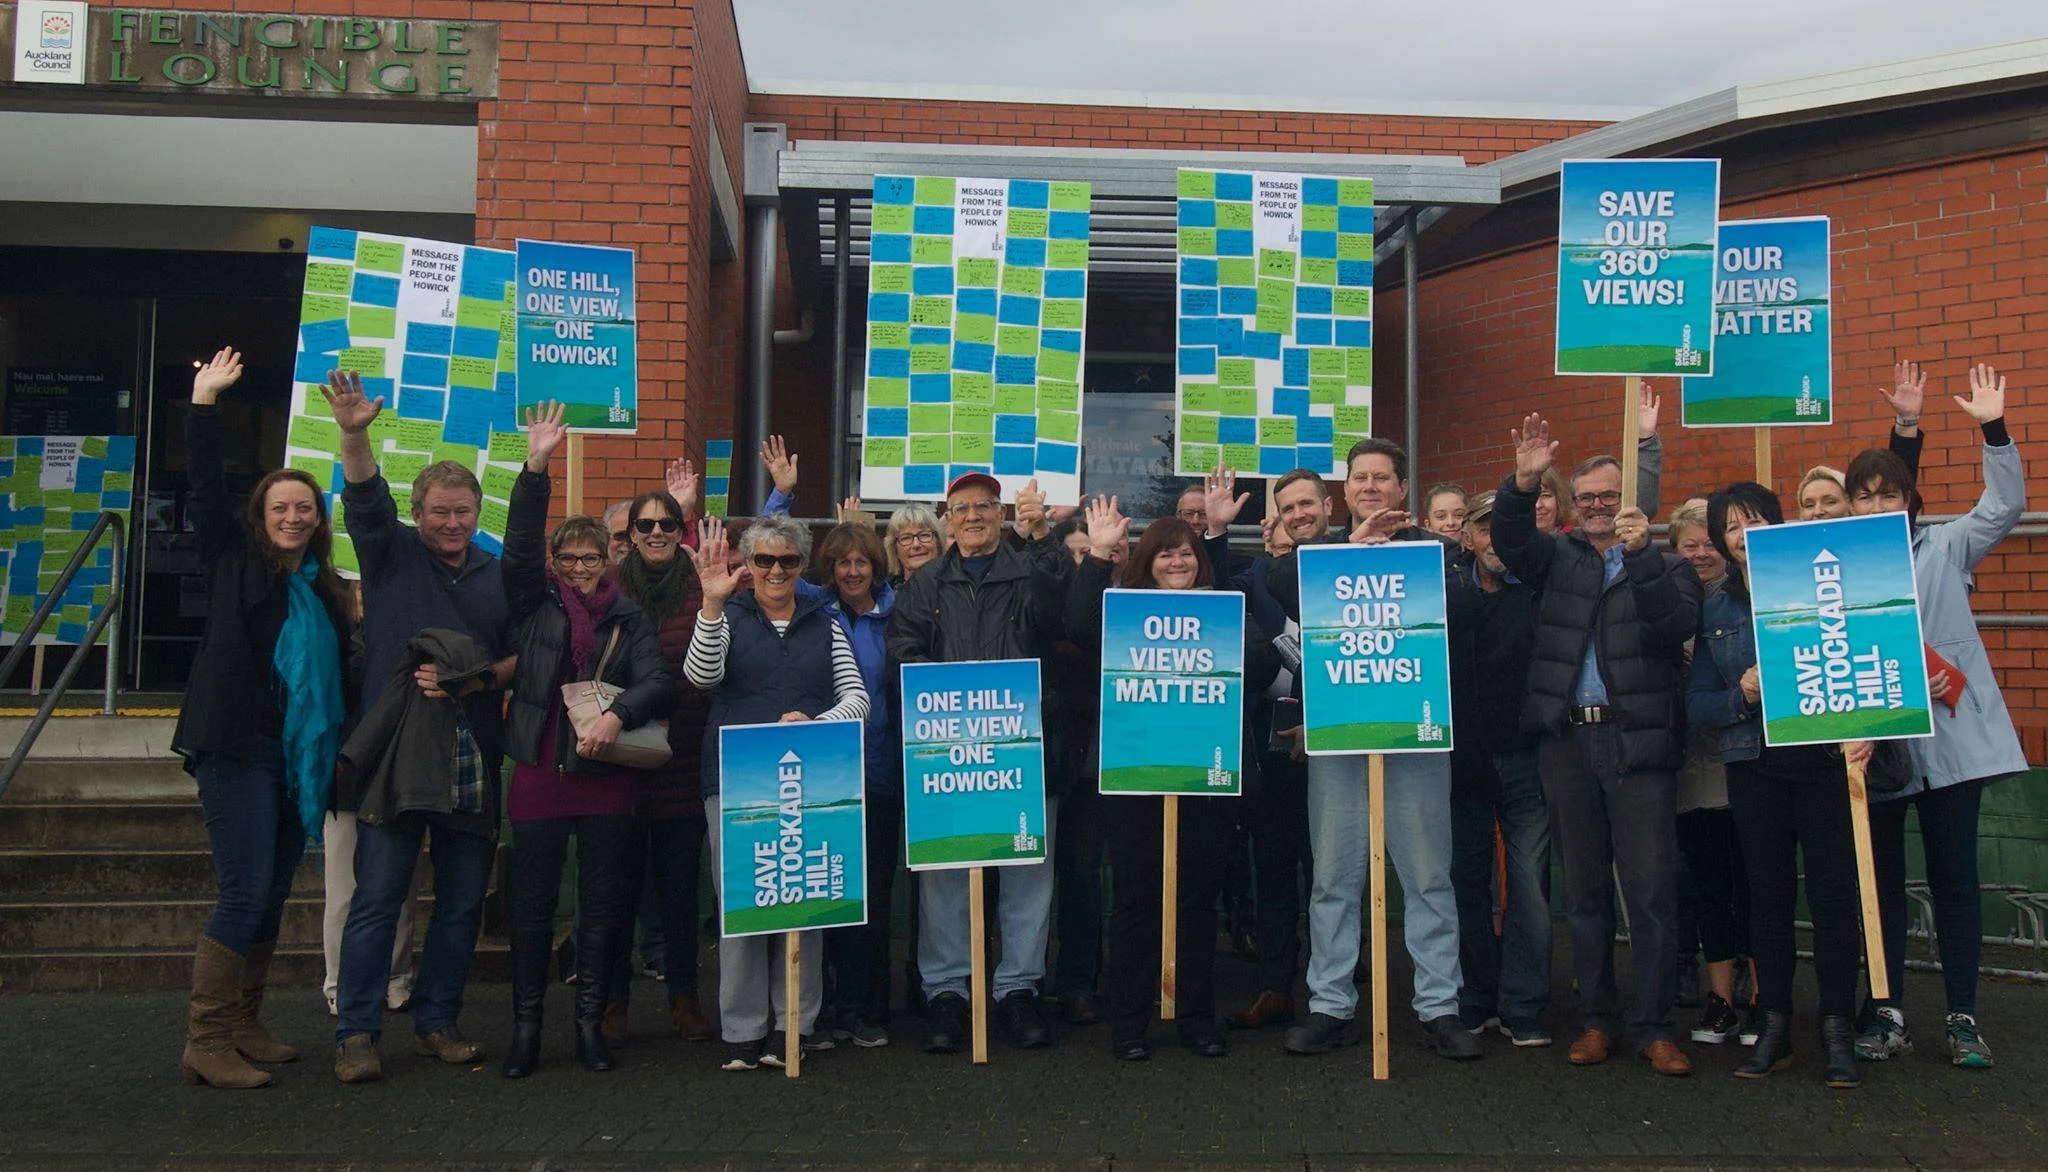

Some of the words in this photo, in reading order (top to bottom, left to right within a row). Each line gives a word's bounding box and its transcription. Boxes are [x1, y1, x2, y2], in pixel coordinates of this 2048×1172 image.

[110, 9, 471, 56] FENCIBLE
[24, 50, 73, 62] Auckland
[34, 60, 71, 70] Council
[109, 52, 471, 94] LOUNGE
[961, 188, 1004, 197] MESSAGES
[1260, 181, 1298, 190] MESSAGES
[960, 208, 990, 216] PEOPLE
[962, 198, 985, 206] FROM
[987, 199, 1002, 207] THE
[1599, 190, 1675, 217] SAVE
[965, 218, 998, 227] HOWICK
[1604, 220, 1667, 246] OUR
[411, 248, 460, 262] MESSAGES
[411, 260, 437, 270] FROM
[439, 262, 457, 272] THE
[1599, 248, 1670, 276] 360°
[1722, 246, 1782, 272] OUR
[409, 270, 442, 282] PEOPLE
[444, 273, 457, 283] OF
[413, 281, 450, 293] HOWICK
[528, 268, 569, 289] ONE
[572, 272, 620, 296] HILL,
[1583, 280, 1685, 306] VIEWS!
[1716, 277, 1798, 304] VIEWS
[526, 294, 566, 315] ONE
[568, 297, 623, 321] VIEW,
[554, 320, 594, 340] ONE
[532, 344, 618, 366] HOWICK!
[1335, 574, 1406, 600] SAVE
[1144, 615, 1200, 640] OUR
[1342, 602, 1400, 628] OUR
[1339, 630, 1405, 656] 360°
[1814, 565, 1855, 712] STOCKADE
[1129, 648, 1214, 672] VIEWS
[1325, 658, 1422, 684] VIEWS!
[1794, 644, 1826, 716] SAVE
[1852, 645, 1885, 708] HILL
[1884, 658, 1904, 710] VIEWS
[916, 692, 962, 713] ONE
[967, 689, 1024, 714] HILL,
[1116, 678, 1226, 704] MATTER
[914, 720, 960, 740] ONE
[963, 716, 1028, 740] VIEW,
[949, 744, 995, 766] ONE
[922, 768, 1022, 794] HOWICK!
[778, 764, 804, 904] STOCKADE
[754, 840, 778, 908] SAVE
[805, 840, 829, 900] HILL
[832, 854, 844, 900] VIEWS
